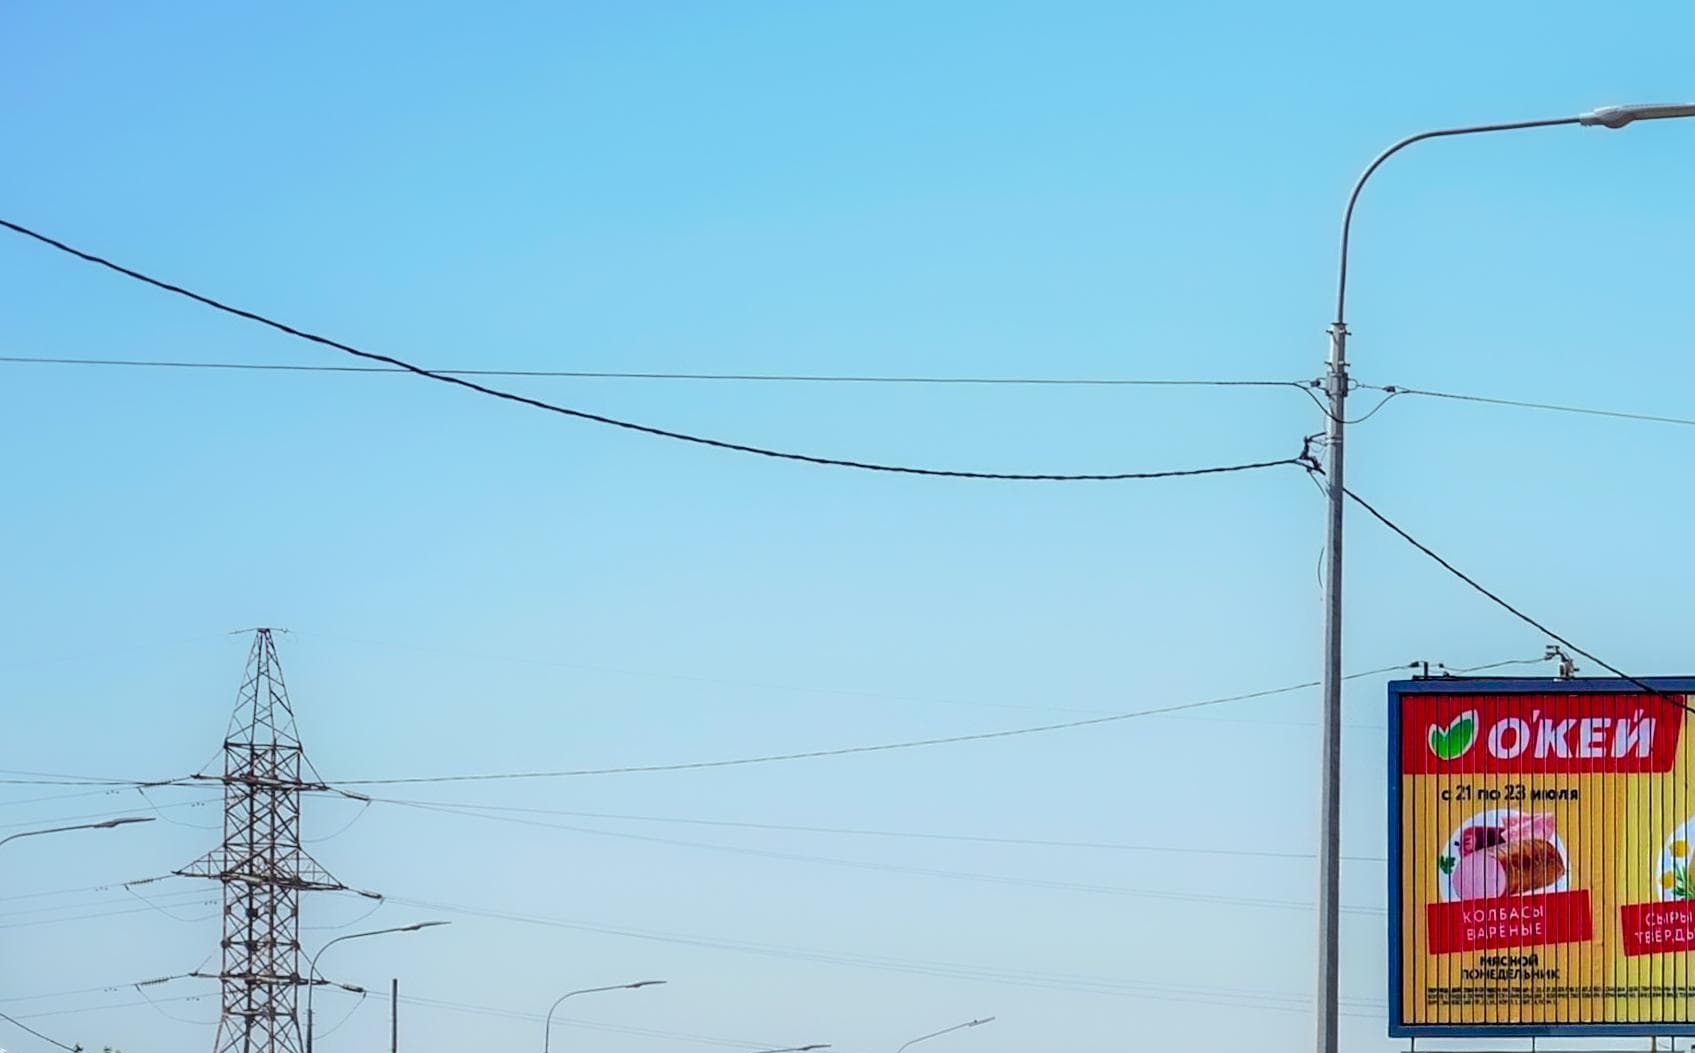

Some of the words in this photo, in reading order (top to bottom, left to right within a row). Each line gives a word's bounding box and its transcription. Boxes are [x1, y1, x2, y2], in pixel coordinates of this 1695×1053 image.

[1455, 784, 1472, 801] 21
[1477, 789, 1501, 800] по
[1504, 784, 1527, 801] 23
[1531, 789, 1579, 801] июля
[1462, 905, 1544, 924] КОЛБАСЫ
[1645, 908, 1694, 927] СЫРЫ
[1480, 953, 1539, 966] МЯСНОЙ
[1462, 968, 1561, 981] ПОНЕДЕЛЬНИК
